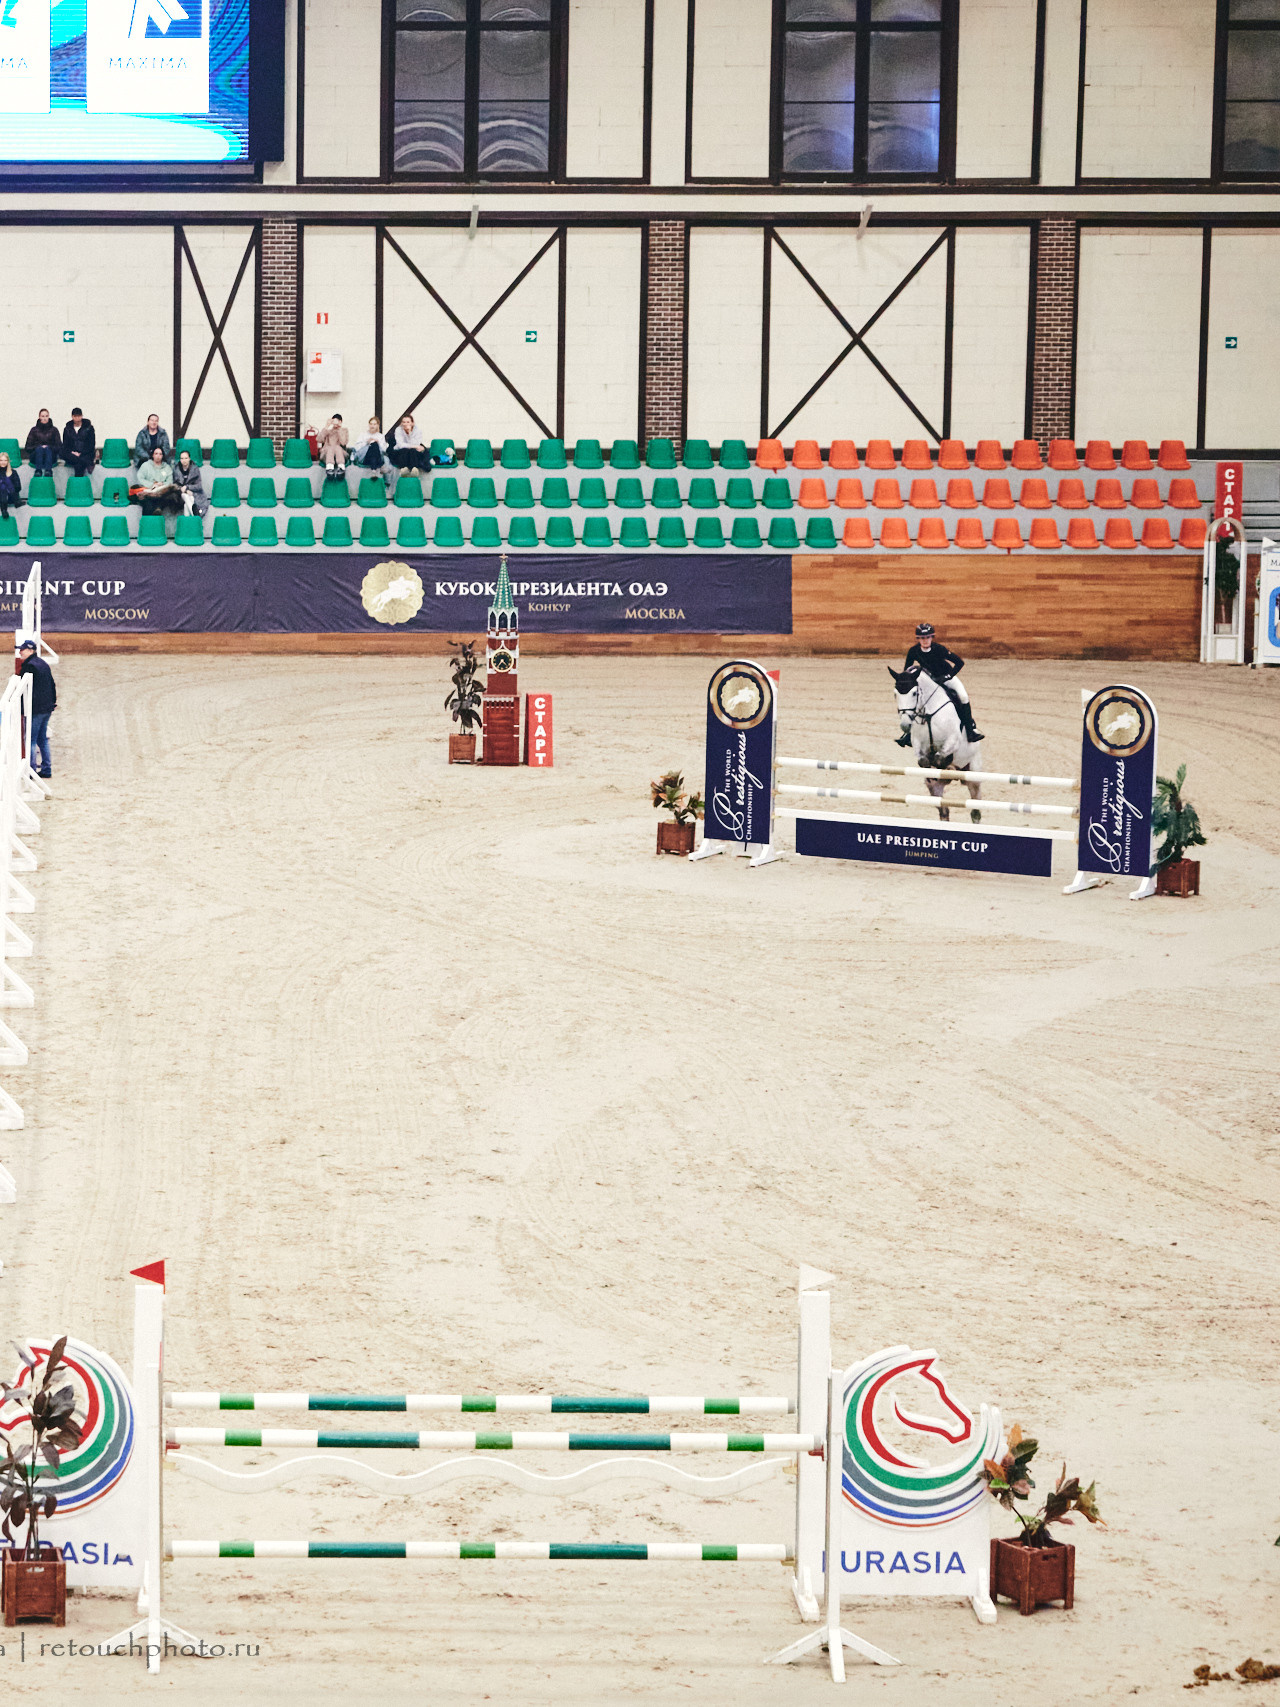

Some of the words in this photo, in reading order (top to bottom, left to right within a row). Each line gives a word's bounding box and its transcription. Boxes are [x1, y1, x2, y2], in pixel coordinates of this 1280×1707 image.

[109, 57, 187, 69] MAXIMA
[82, 580, 126, 596] CUP
[435, 581, 496, 596] КУБОК
[508, 581, 624, 597] ПРЕЗИДЕНТА
[628, 582, 668, 596] ОАЭ
[84, 608, 150, 620] MOSCOW
[625, 608, 686, 620] МОСКВА
[534, 697, 547, 765] СТАРТ
[713, 730, 764, 841] Prestigious
[1088, 758, 1144, 873] Prestigious
[857, 832, 882, 844] UAE
[886, 835, 958, 851] PRESIDENT
[961, 841, 989, 853] CUP
[822, 1550, 966, 1574] URASIA
